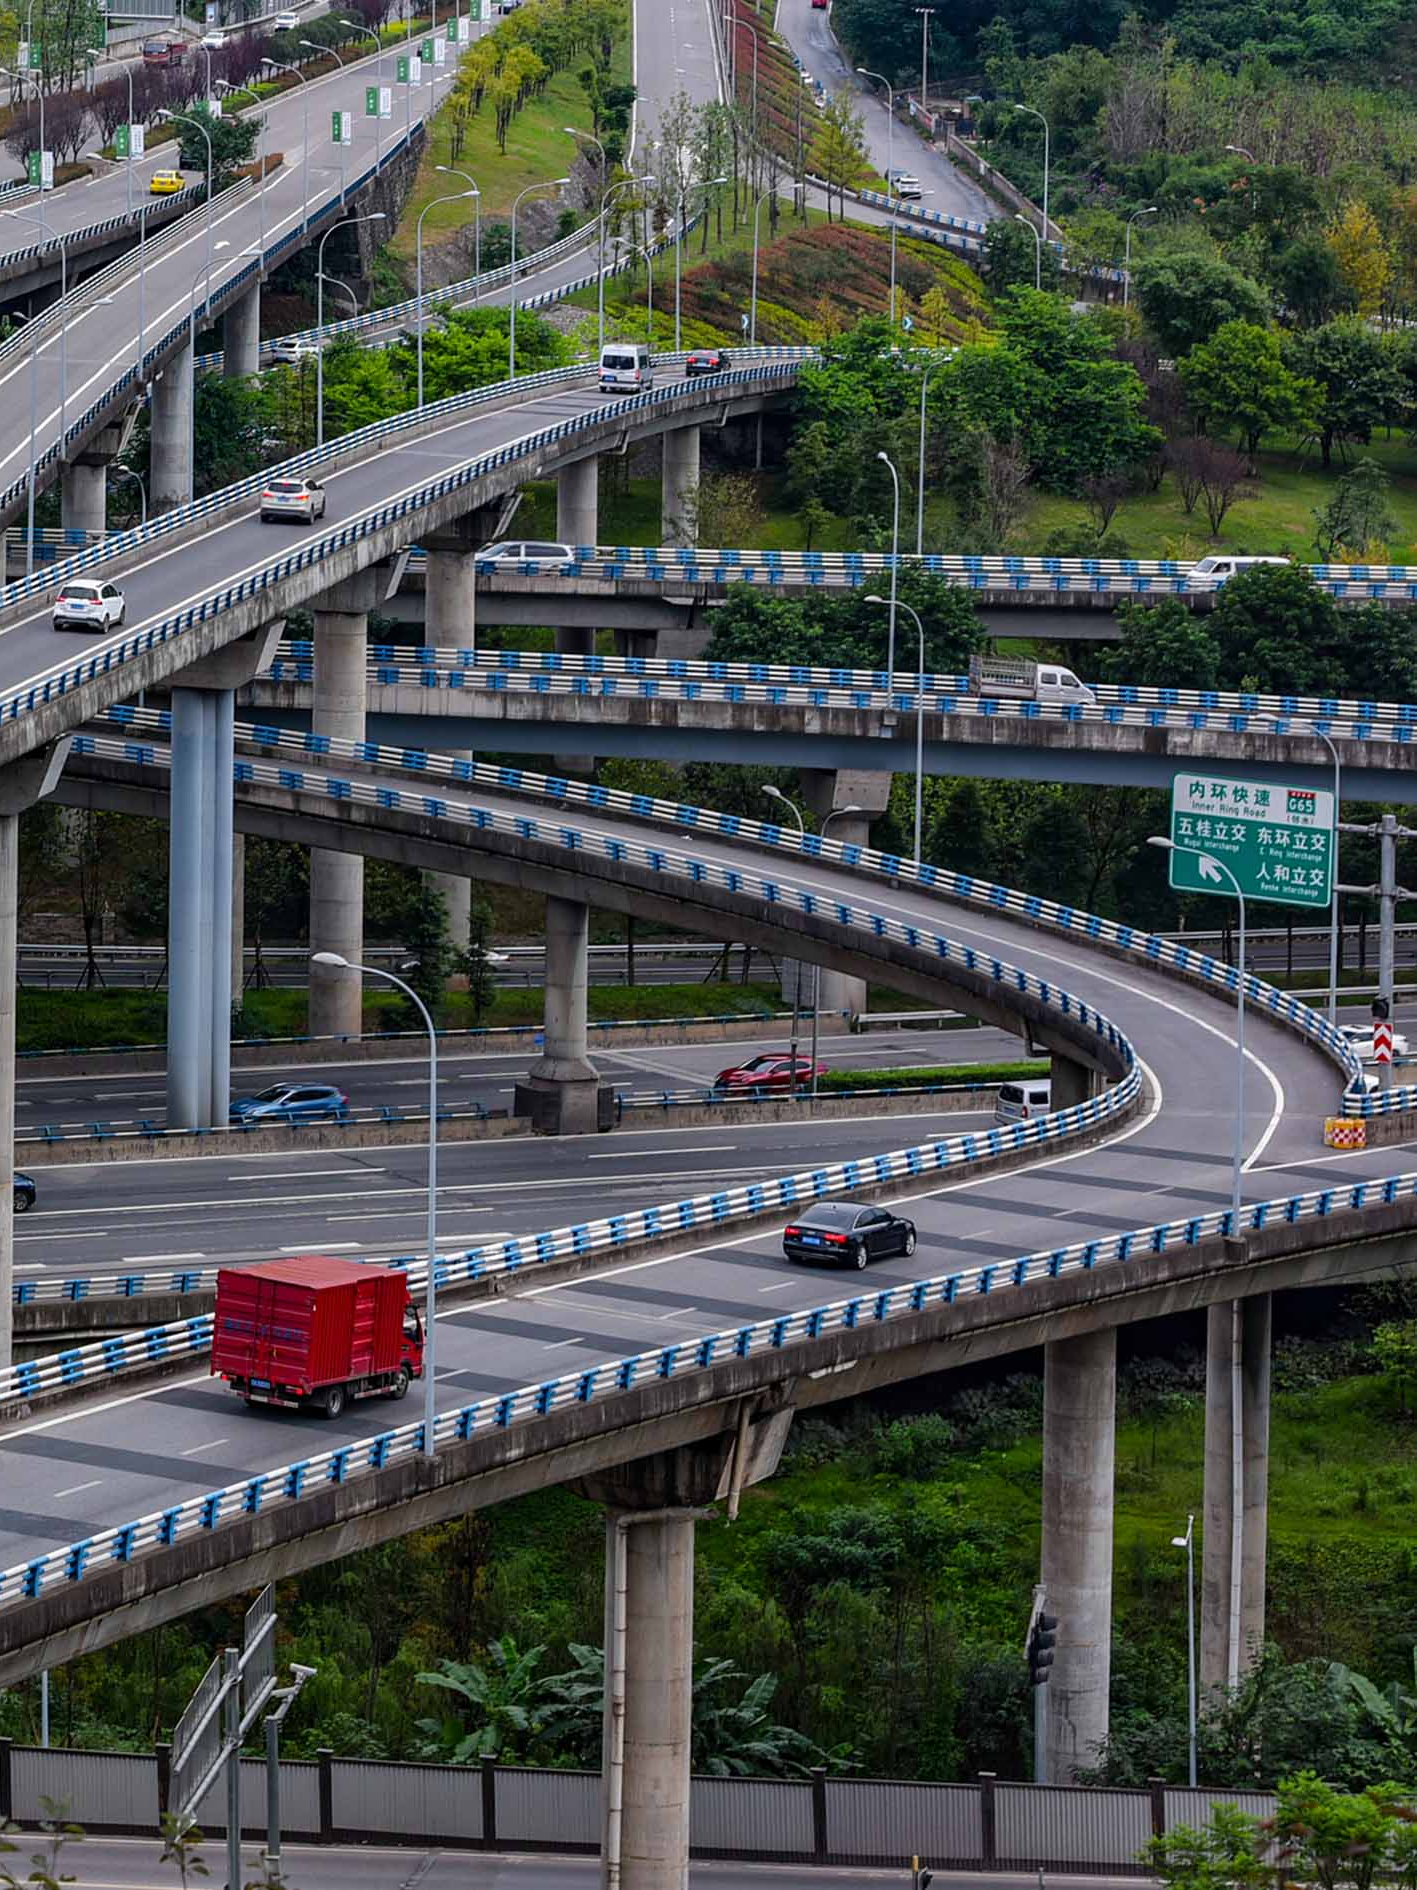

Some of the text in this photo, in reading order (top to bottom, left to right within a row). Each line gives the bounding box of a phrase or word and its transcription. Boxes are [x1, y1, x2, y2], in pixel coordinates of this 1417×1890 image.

[1189, 780, 1271, 807] 内环快速
[1289, 798, 1314, 813] G65
[1191, 800, 1267, 818] Inner Ring Road
[1177, 817, 1247, 843] 五桂立交
[1257, 826, 1327, 852] 东环立交
[1256, 861, 1326, 887] 人和立交
